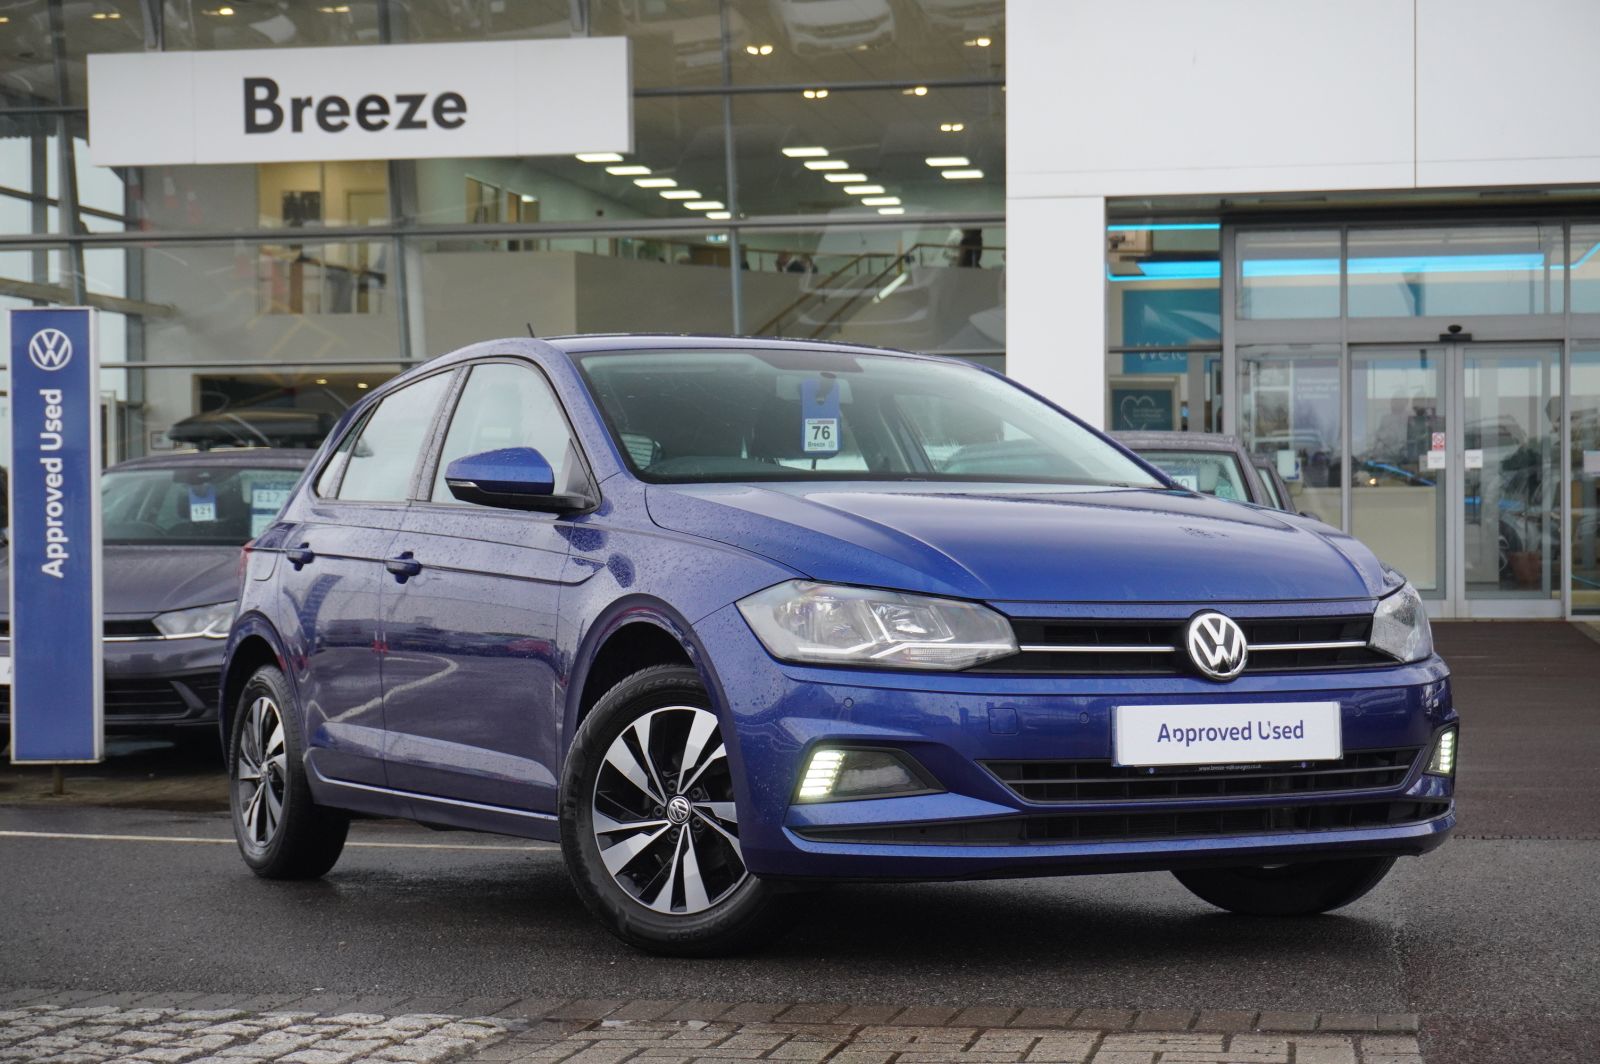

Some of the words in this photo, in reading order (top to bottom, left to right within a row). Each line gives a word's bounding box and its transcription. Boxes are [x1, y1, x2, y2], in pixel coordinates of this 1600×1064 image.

[243, 77, 468, 135] Breeze
[39, 389, 63, 451] Used
[812, 425, 831, 441] 76
[41, 458, 69, 578] Approved
[1157, 721, 1252, 747] Approved
[1258, 719, 1305, 740] Used
